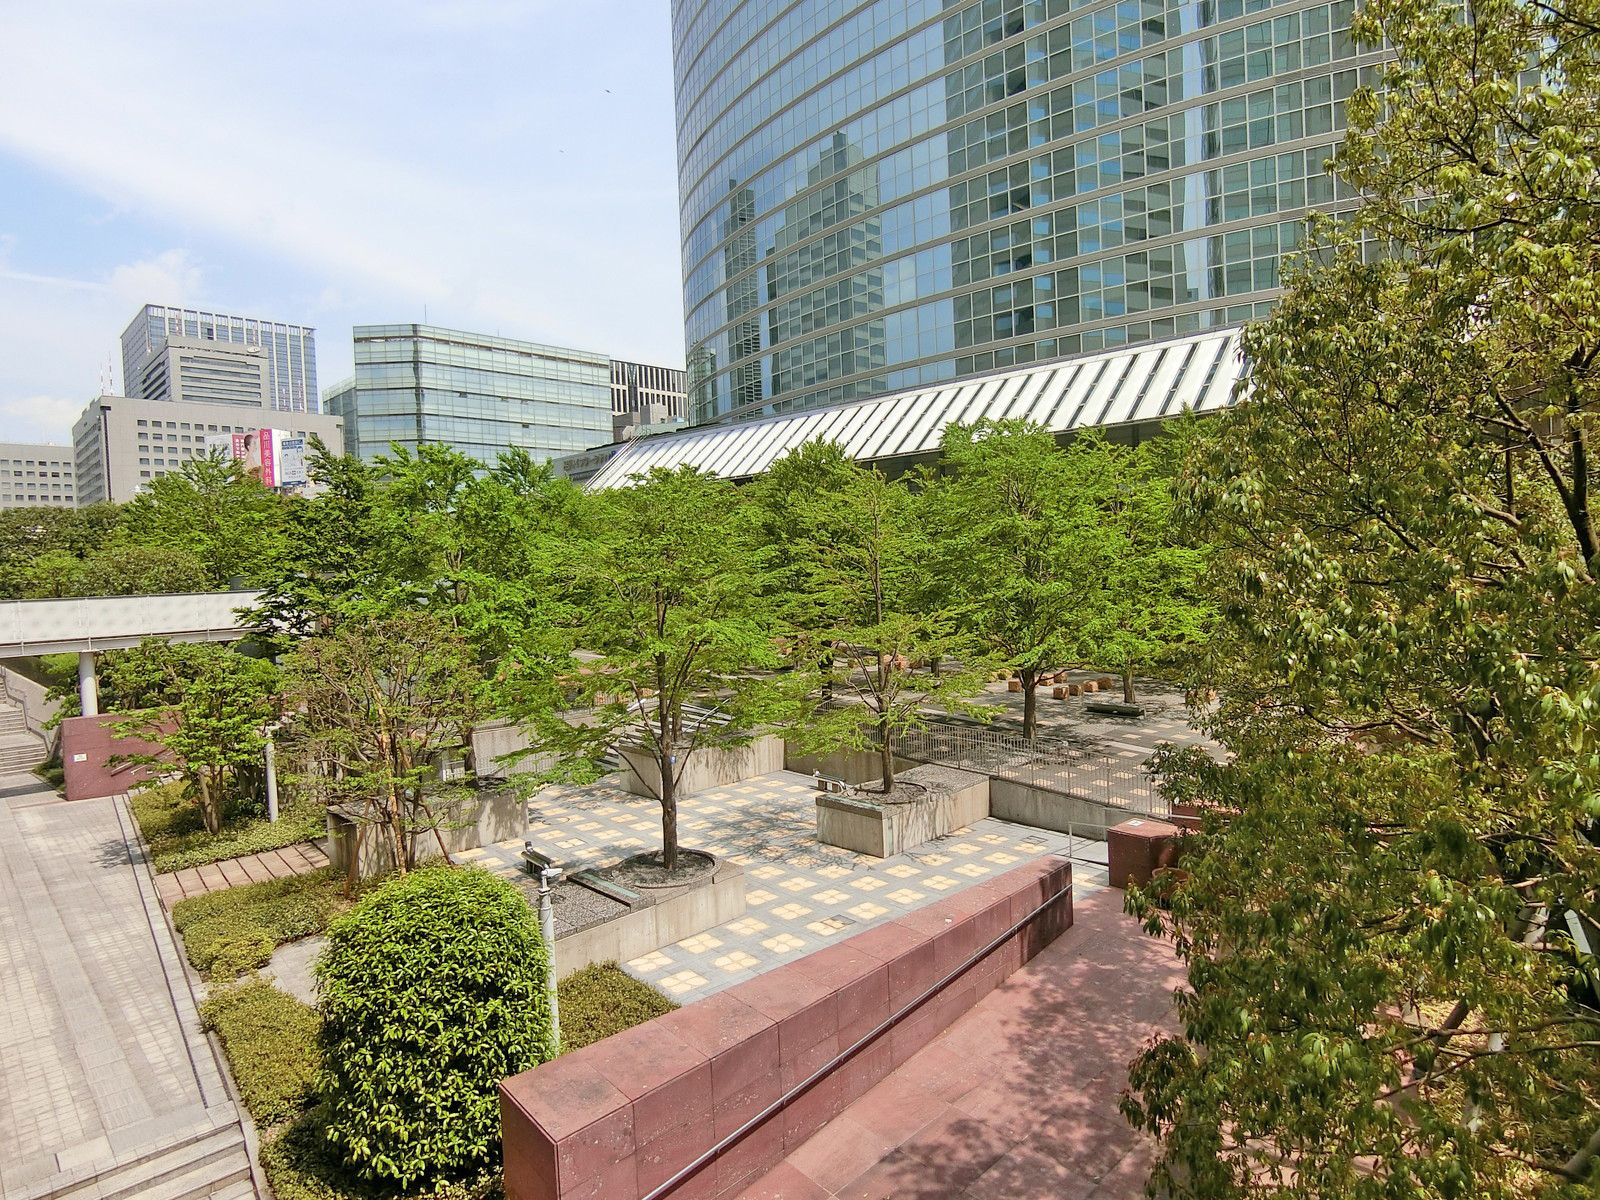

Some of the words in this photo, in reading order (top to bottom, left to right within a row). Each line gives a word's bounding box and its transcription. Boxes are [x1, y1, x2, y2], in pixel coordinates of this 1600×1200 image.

[263, 432, 272, 485] 品川美容外科
